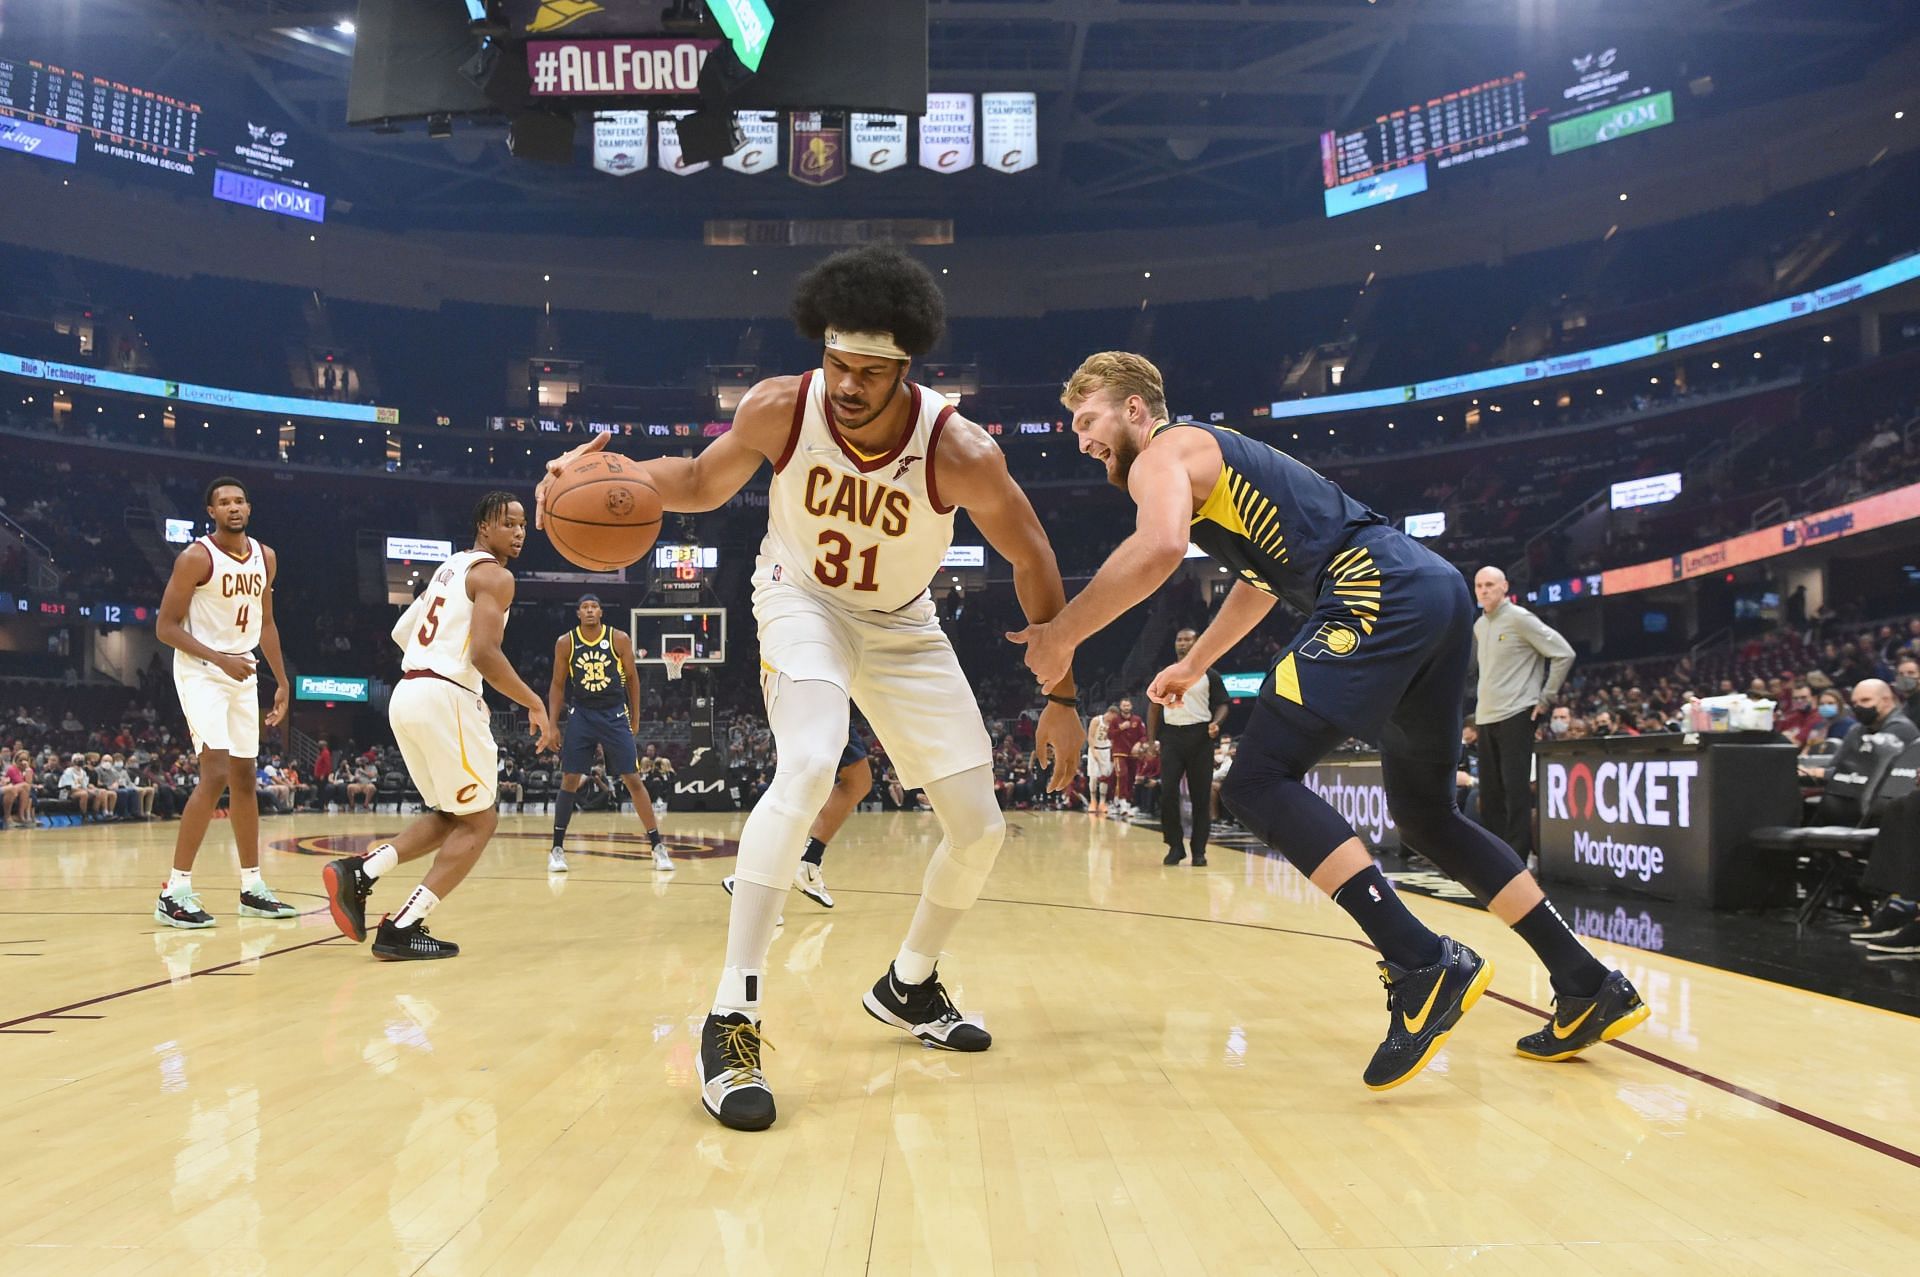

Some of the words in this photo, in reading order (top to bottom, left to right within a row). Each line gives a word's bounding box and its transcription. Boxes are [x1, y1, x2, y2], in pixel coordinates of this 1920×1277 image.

[929, 114, 965, 122] EASTERN
[987, 106, 1033, 115] CHAMPIONS
[597, 128, 645, 136] CONFERENCE
[856, 134, 901, 143] CHAMPIONS
[922, 125, 972, 134] CONFERENCE
[600, 139, 643, 148] CHAMPIONS
[924, 136, 970, 144] CHAMPIONS
[110, 146, 135, 159] FIRST
[136, 152, 159, 166] TEAM
[21, 361, 38, 375] Blue
[46, 364, 96, 387] Technologies
[184, 387, 234, 403] Lexmark
[589, 422, 619, 435] FOULS
[624, 424, 632, 435] 2
[649, 425, 670, 436] FG%
[1020, 422, 1050, 434] FOULS
[1056, 422, 1064, 433] 2
[804, 464, 910, 538] CAVS
[814, 529, 880, 592] 31
[222, 573, 262, 598] CAVS
[1548, 584, 1562, 602] 12
[105, 606, 121, 623] 12
[235, 603, 249, 633] 4
[417, 596, 446, 648] 5
[575, 650, 611, 669] INDIANA
[583, 662, 605, 680] 33
[302, 678, 365, 698] FirstEnergy
[1547, 761, 1698, 827] ROCKET
[1304, 771, 1394, 843] Mortgage
[1574, 830, 1664, 882] Mortgage
